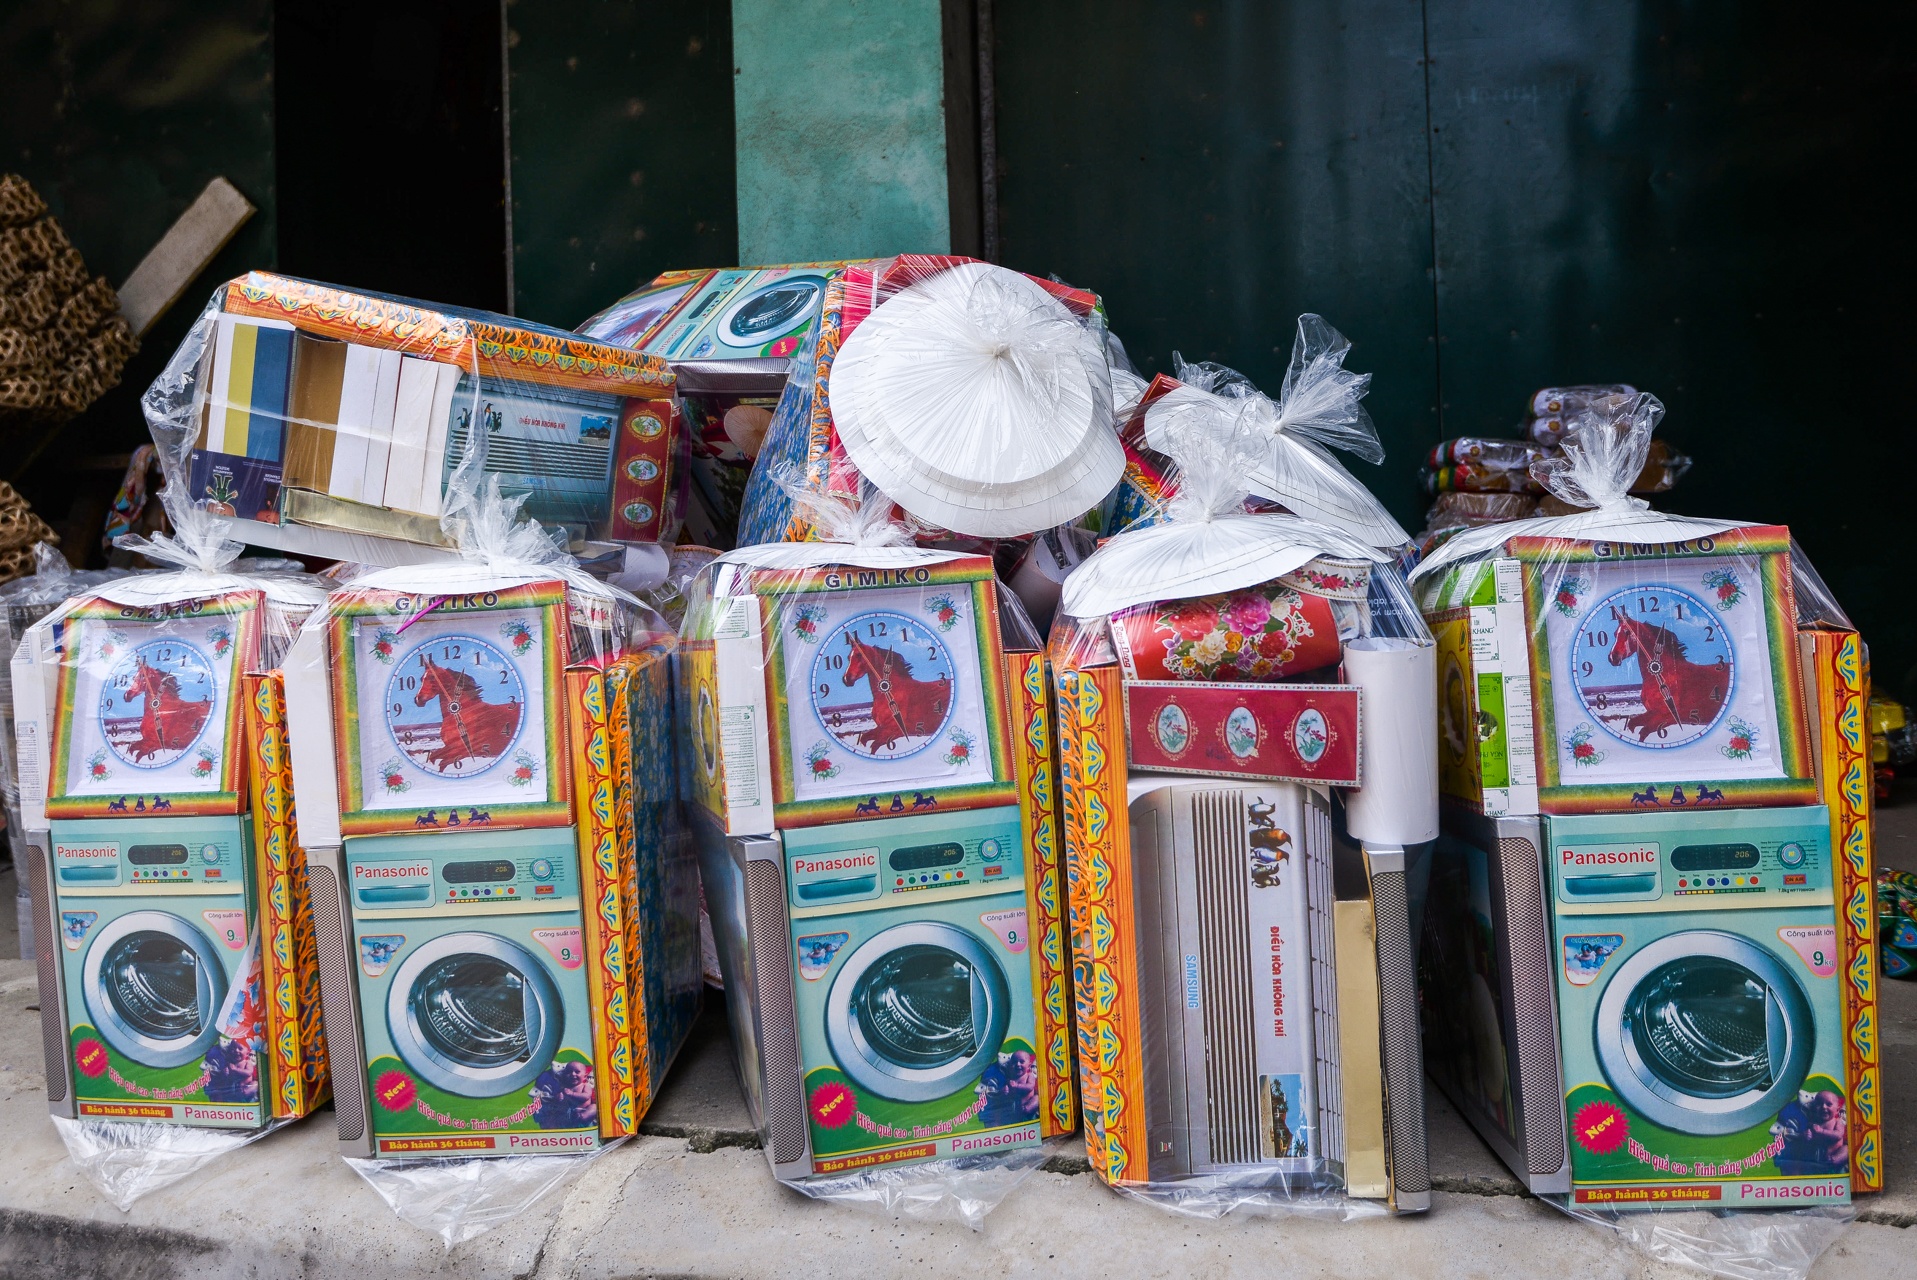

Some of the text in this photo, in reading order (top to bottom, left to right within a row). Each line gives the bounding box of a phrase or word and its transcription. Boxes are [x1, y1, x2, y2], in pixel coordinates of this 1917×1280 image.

[1593, 537, 1715, 557] GIMIKO
[825, 568, 930, 588] GIMIKO
[1638, 596, 1659, 613] 12
[1609, 604, 1627, 620] 11
[1675, 604, 1684, 620] 1
[868, 622, 887, 637] 12
[901, 628, 909, 642] 1
[1704, 626, 1715, 642] 2
[844, 630, 858, 645] 11
[1586, 631, 1608, 647] 10
[156, 649, 171, 661] 12
[444, 646, 461, 659] 12
[475, 652, 482, 665] 1
[928, 647, 937, 661] 2
[180, 655, 187, 667] 1
[419, 653, 433, 667] 11
[824, 655, 843, 670] 10
[1715, 655, 1725, 671] 3
[1582, 662, 1593, 677] 9
[113, 675, 127, 687] 10
[198, 673, 205, 683] 2
[398, 676, 415, 690] 10
[500, 671, 508, 684] 2
[938, 672, 946, 686] 3
[820, 684, 829, 698] 9
[1710, 686, 1720, 702] 4
[106, 699, 113, 711] 9
[200, 695, 207, 706] 3
[508, 696, 516, 710] 3
[933, 699, 943, 714] 4
[1596, 694, 1607, 710] 8
[394, 703, 402, 717] 9
[832, 713, 842, 727] 8
[1619, 715, 1629, 731] 7
[1689, 710, 1699, 725] 5
[111, 724, 118, 737] 8
[191, 720, 199, 730] 4
[502, 723, 510, 737] 4
[916, 722, 925, 736] 5
[1657, 722, 1668, 738] 6
[172, 738, 179, 749] 5
[405, 732, 413, 745] 8
[887, 736, 896, 750] 6
[423, 750, 431, 763] 7
[482, 745, 490, 758] 5
[454, 756, 462, 769] 6
[57, 845, 117, 858] Panasonic
[1562, 848, 1655, 865] Panasonic
[795, 853, 876, 874] Panasonic
[355, 864, 429, 878] Panasonic
[987, 914, 1002, 922] Công
[1003, 912, 1016, 920] suất
[1787, 930, 1806, 938] Công
[1185, 954, 1199, 1009] SAMSUNG
[1270, 926, 1287, 1037] ĐIỀU HÒA KHÔNG KHÍ
[82, 1048, 100, 1067] New
[138, 1088, 148, 1096] cao
[383, 1080, 406, 1100] New
[87, 1105, 103, 1114] Bảo
[104, 1106, 126, 1115] hành
[140, 1107, 166, 1117] tháng
[819, 1091, 844, 1117] New
[185, 1107, 254, 1121] Panasonic
[417, 1100, 436, 1120] Hiệu
[452, 1119, 465, 1129] cao
[490, 1117, 508, 1129] năng
[509, 1108, 526, 1124] vượt
[856, 1111, 876, 1134] Hiệu
[894, 1128, 907, 1138] cao
[933, 1120, 952, 1137] năng
[953, 1108, 972, 1128] vượt
[1585, 1114, 1615, 1140] New
[389, 1138, 486, 1150] Bảo hành 36 tháng
[510, 1134, 593, 1147] Panasonic
[952, 1128, 1036, 1152] Panasonic
[822, 1147, 927, 1172] Bảo hành 36 tháng
[1628, 1137, 1651, 1165] Hiệu
[1671, 1161, 1687, 1175] cao
[1718, 1158, 1742, 1176] năng
[1742, 1148, 1765, 1169] vượt
[1587, 1187, 1710, 1200] Bảo hành 36 tháng
[1740, 1182, 1845, 1199] Panasonic
